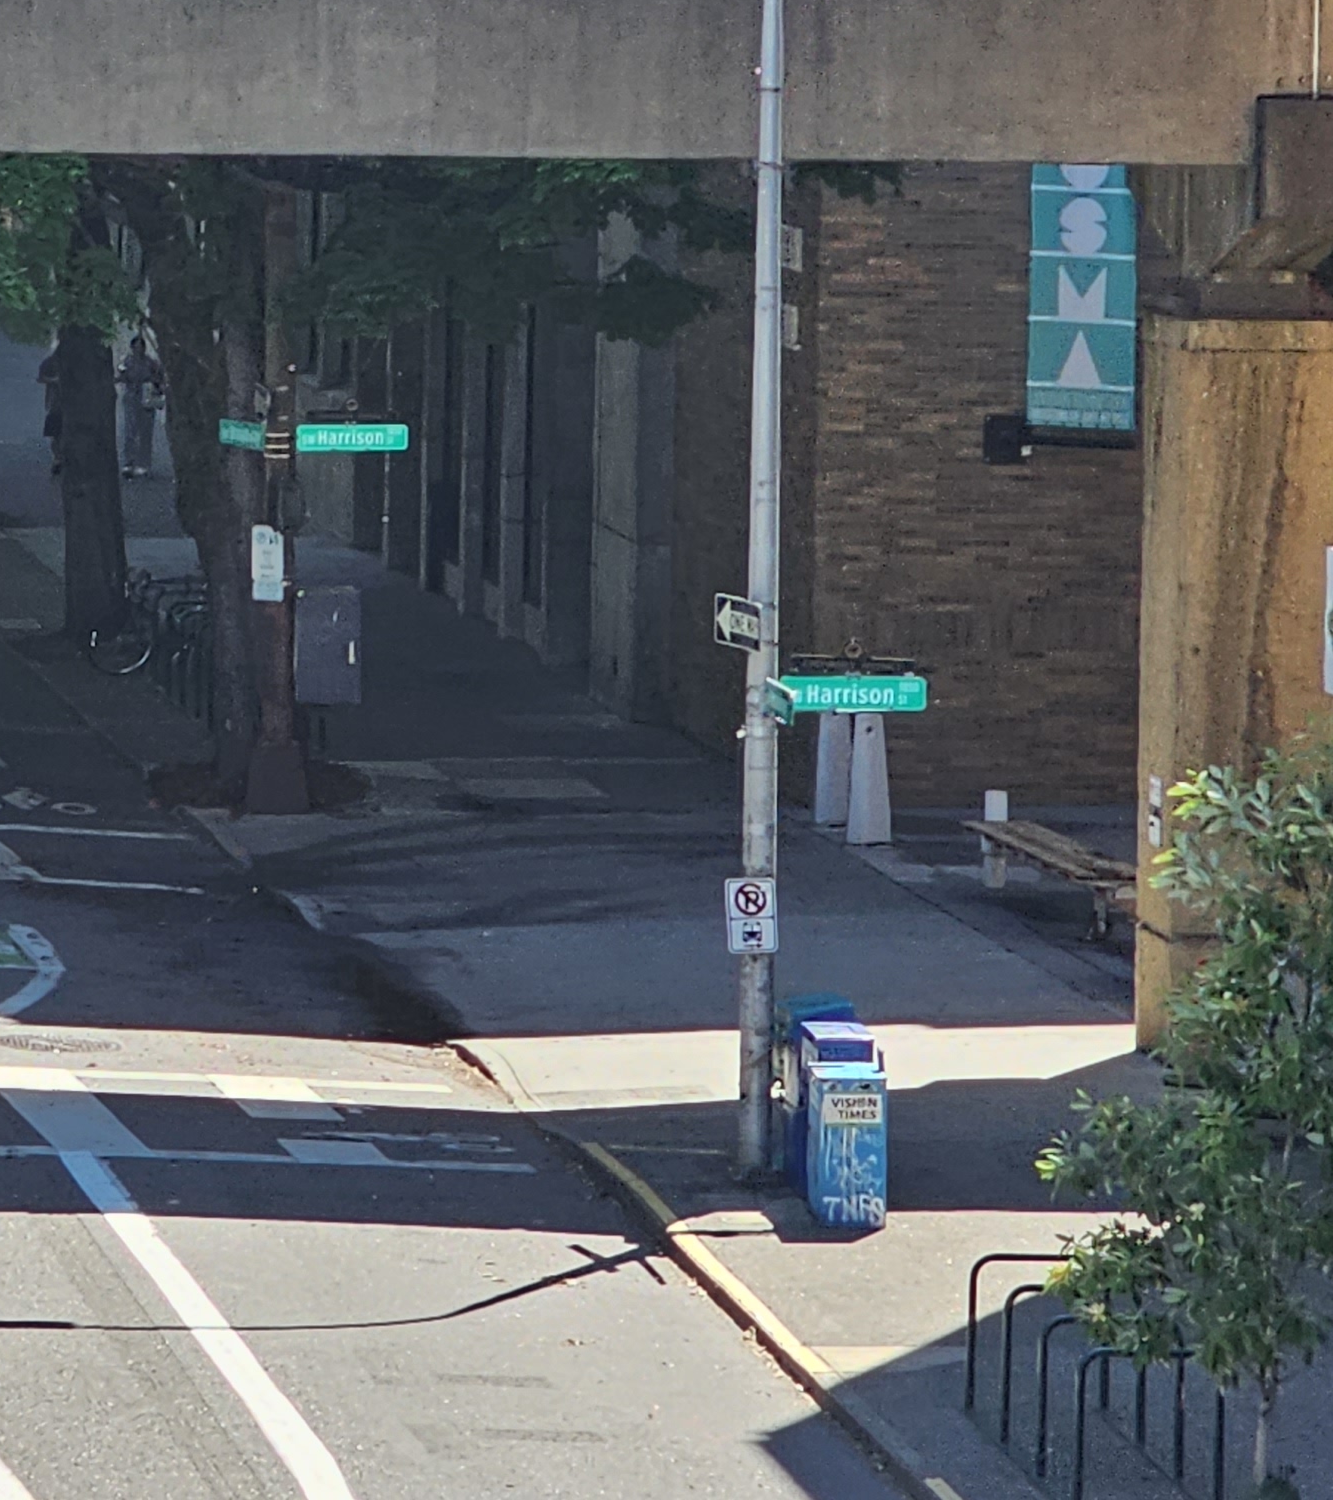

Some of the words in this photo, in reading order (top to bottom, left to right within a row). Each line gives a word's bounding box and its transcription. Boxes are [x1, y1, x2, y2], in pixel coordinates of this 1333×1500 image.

[317, 429, 384, 445] Harrison
[806, 683, 895, 705] Harrison
[837, 1109, 878, 1119] TIMES
